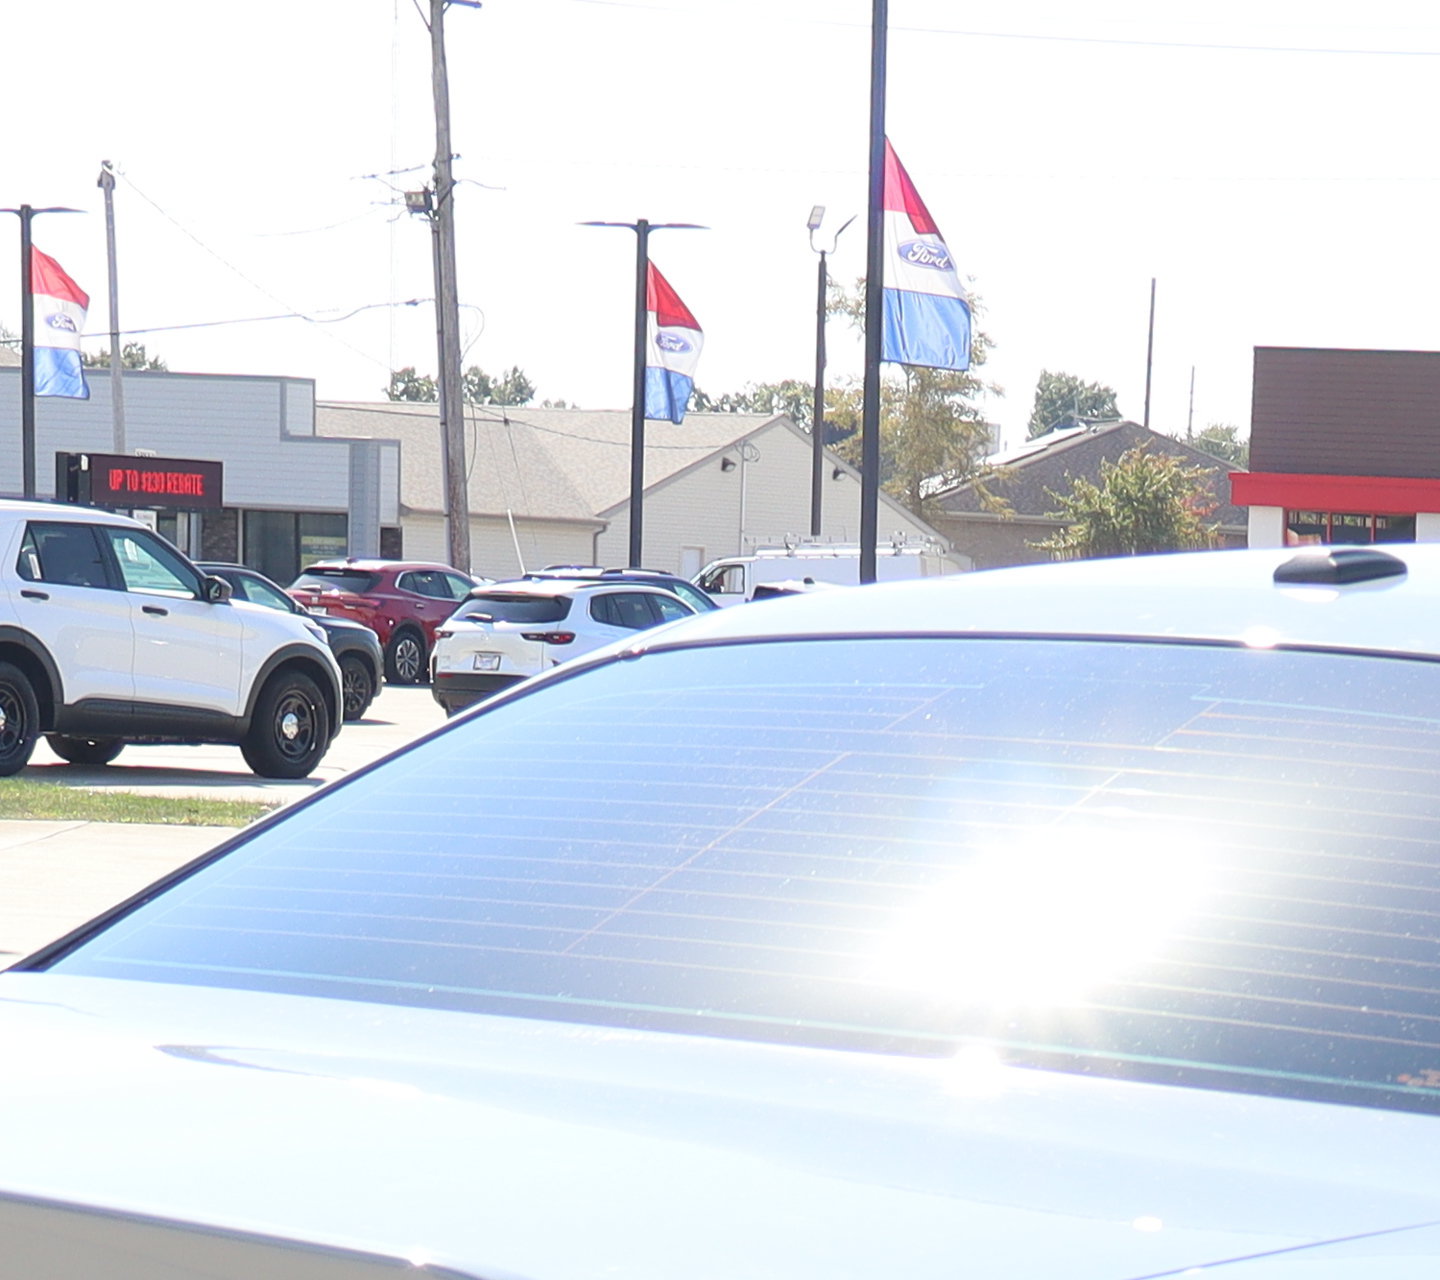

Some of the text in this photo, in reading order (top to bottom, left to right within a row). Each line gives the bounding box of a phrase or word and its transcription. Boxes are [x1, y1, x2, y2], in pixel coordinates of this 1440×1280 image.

[907, 243, 949, 268] Ford
[109, 469, 124, 491] UP
[126, 470, 139, 492] TO
